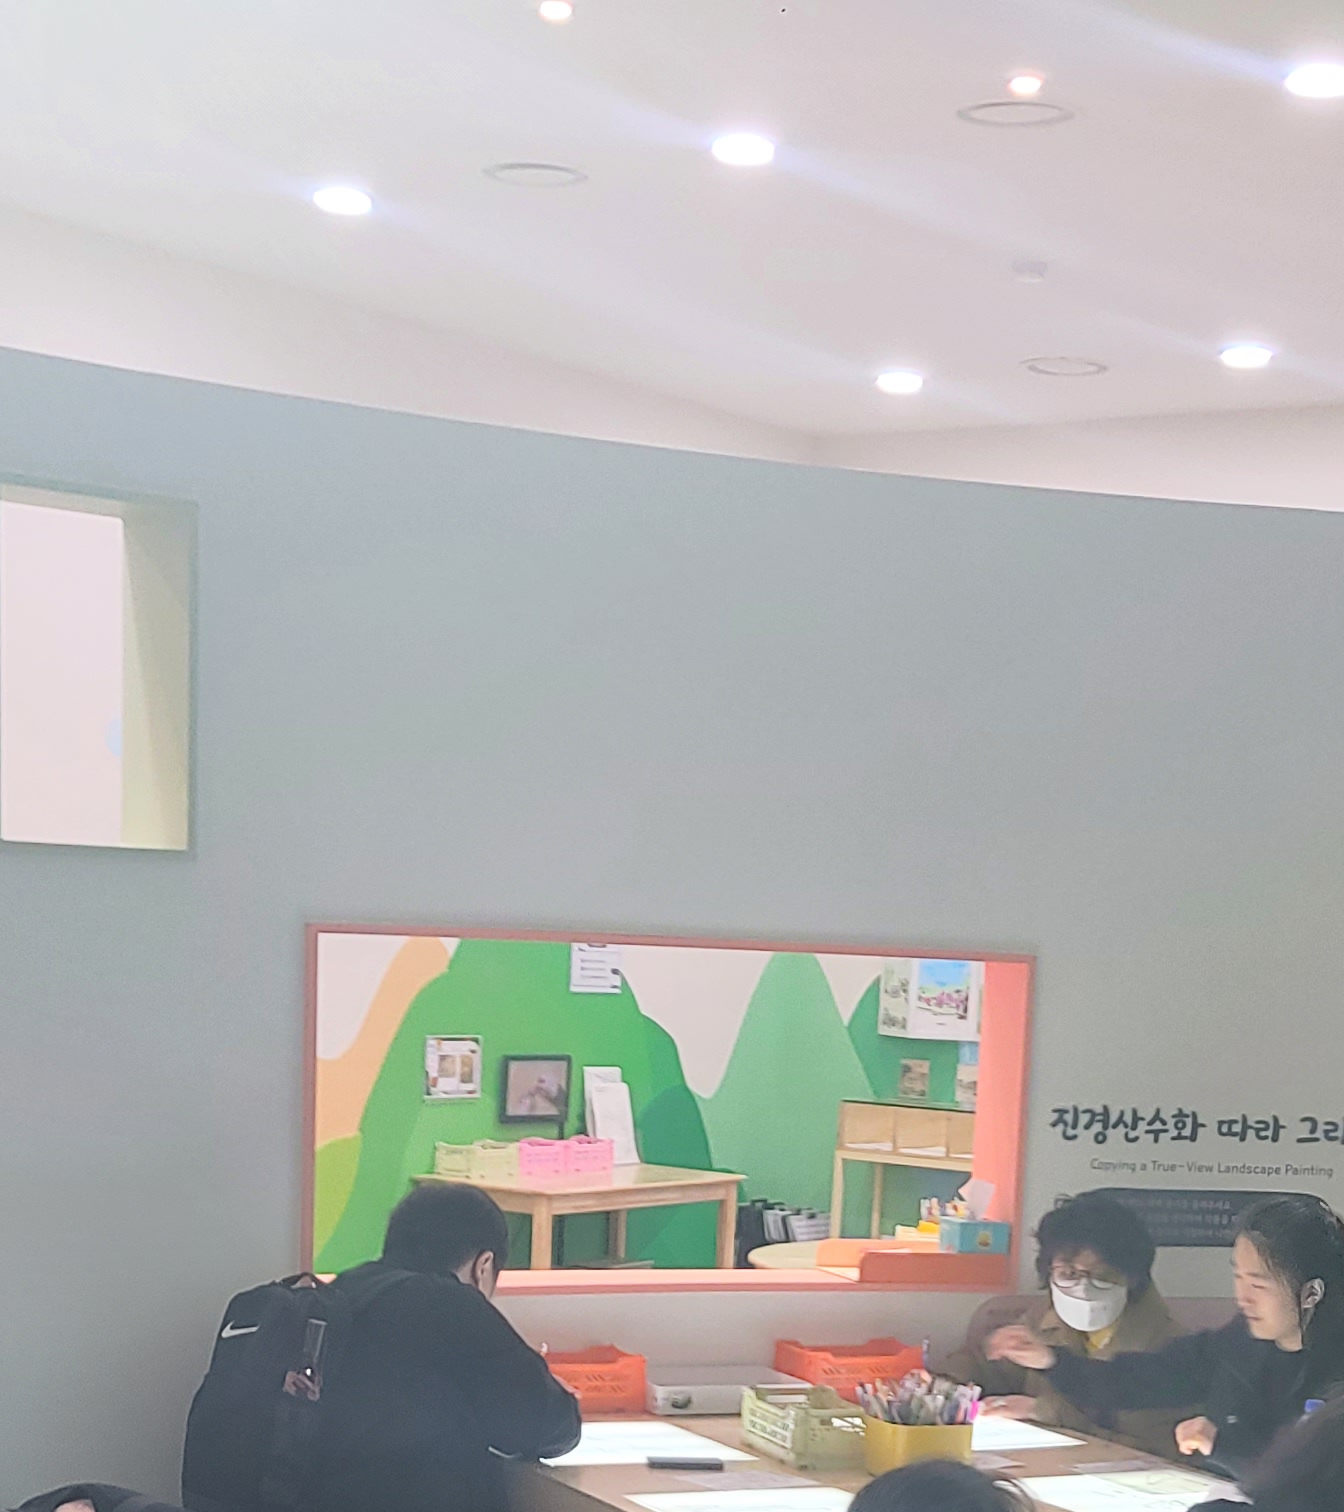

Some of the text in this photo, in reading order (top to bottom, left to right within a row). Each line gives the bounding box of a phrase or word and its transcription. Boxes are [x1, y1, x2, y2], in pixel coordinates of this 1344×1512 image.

[1050, 1104, 1207, 1145] 진경산수화
[1217, 1113, 1287, 1143] 따라
[1140, 1162, 1148, 1172] a
[1151, 1159, 1214, 1173] True-View
[1217, 1161, 1282, 1177] Landscape
[1284, 1163, 1335, 1179] Painting
